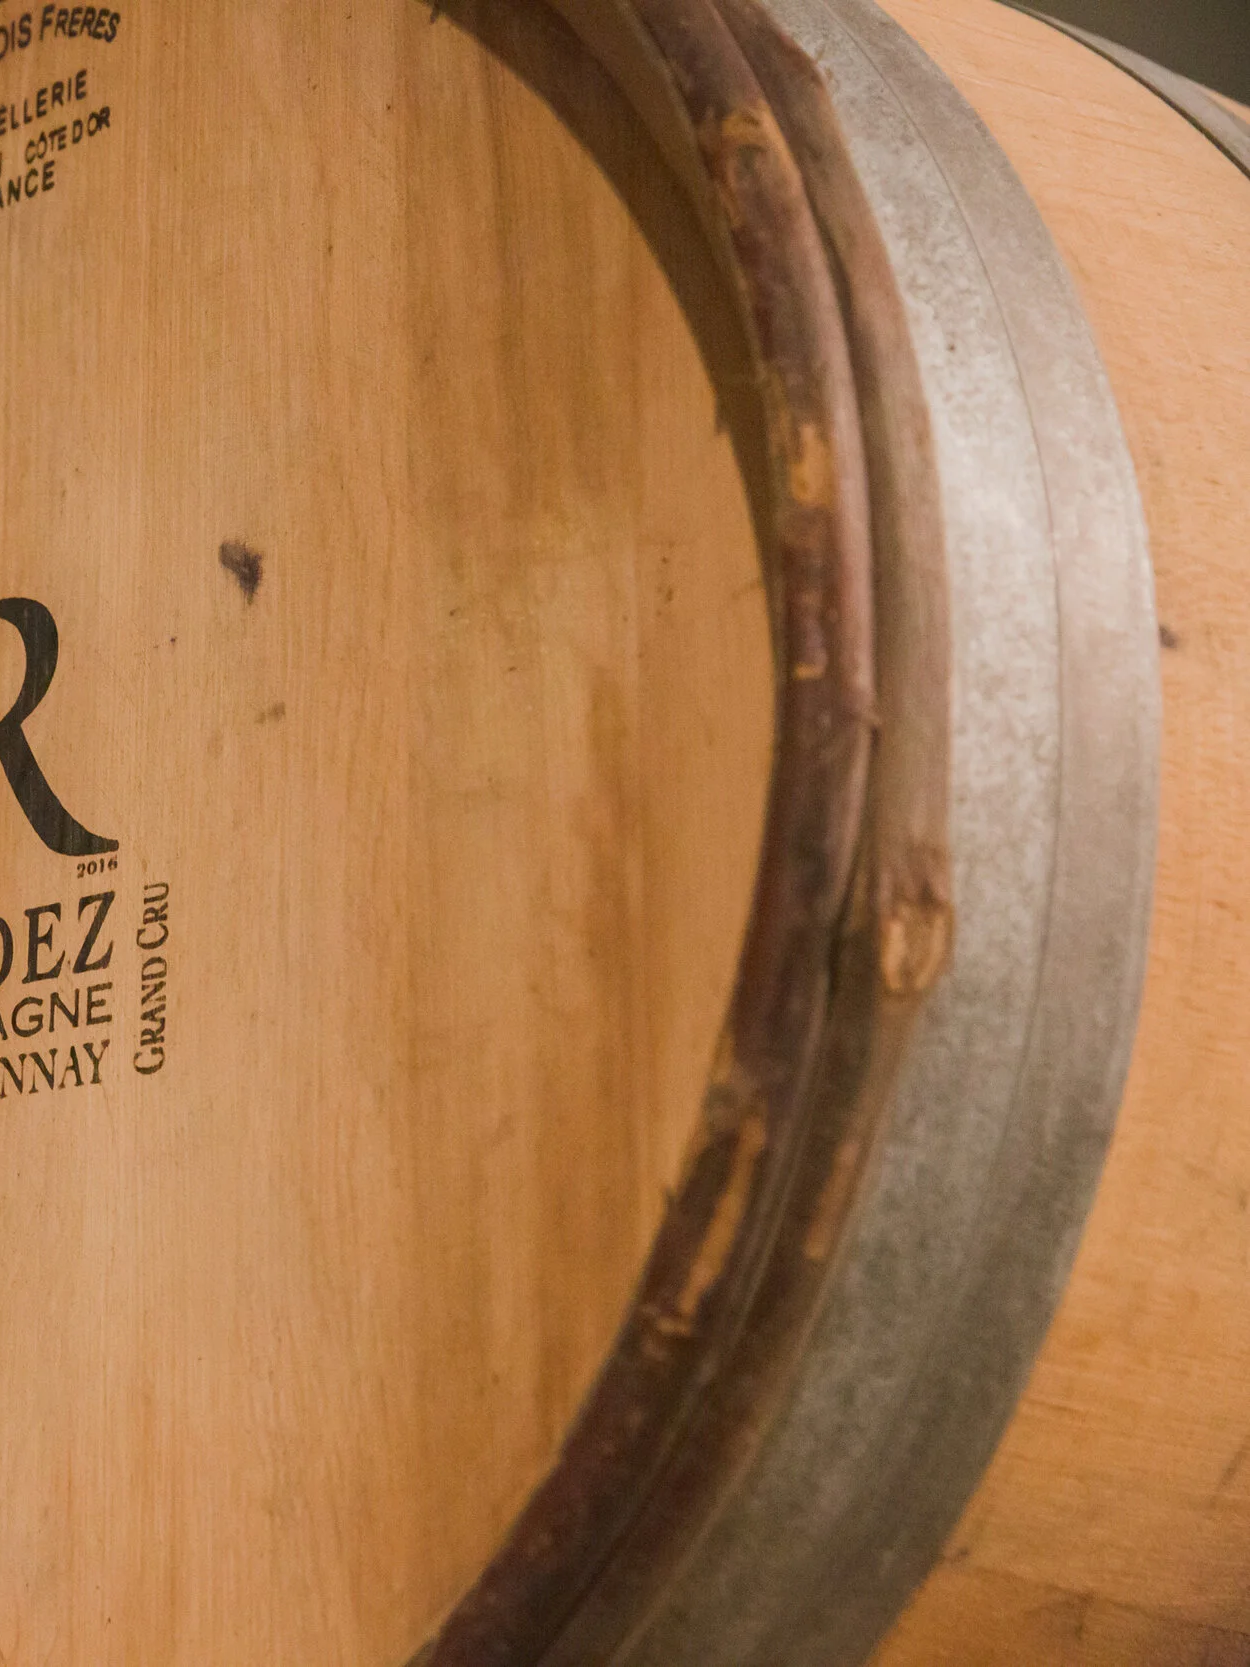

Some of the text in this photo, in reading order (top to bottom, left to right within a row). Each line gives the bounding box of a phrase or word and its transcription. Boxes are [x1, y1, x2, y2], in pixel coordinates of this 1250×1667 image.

[77, 857, 118, 879] 2016
[133, 882, 170, 1075] GRAND CRU
